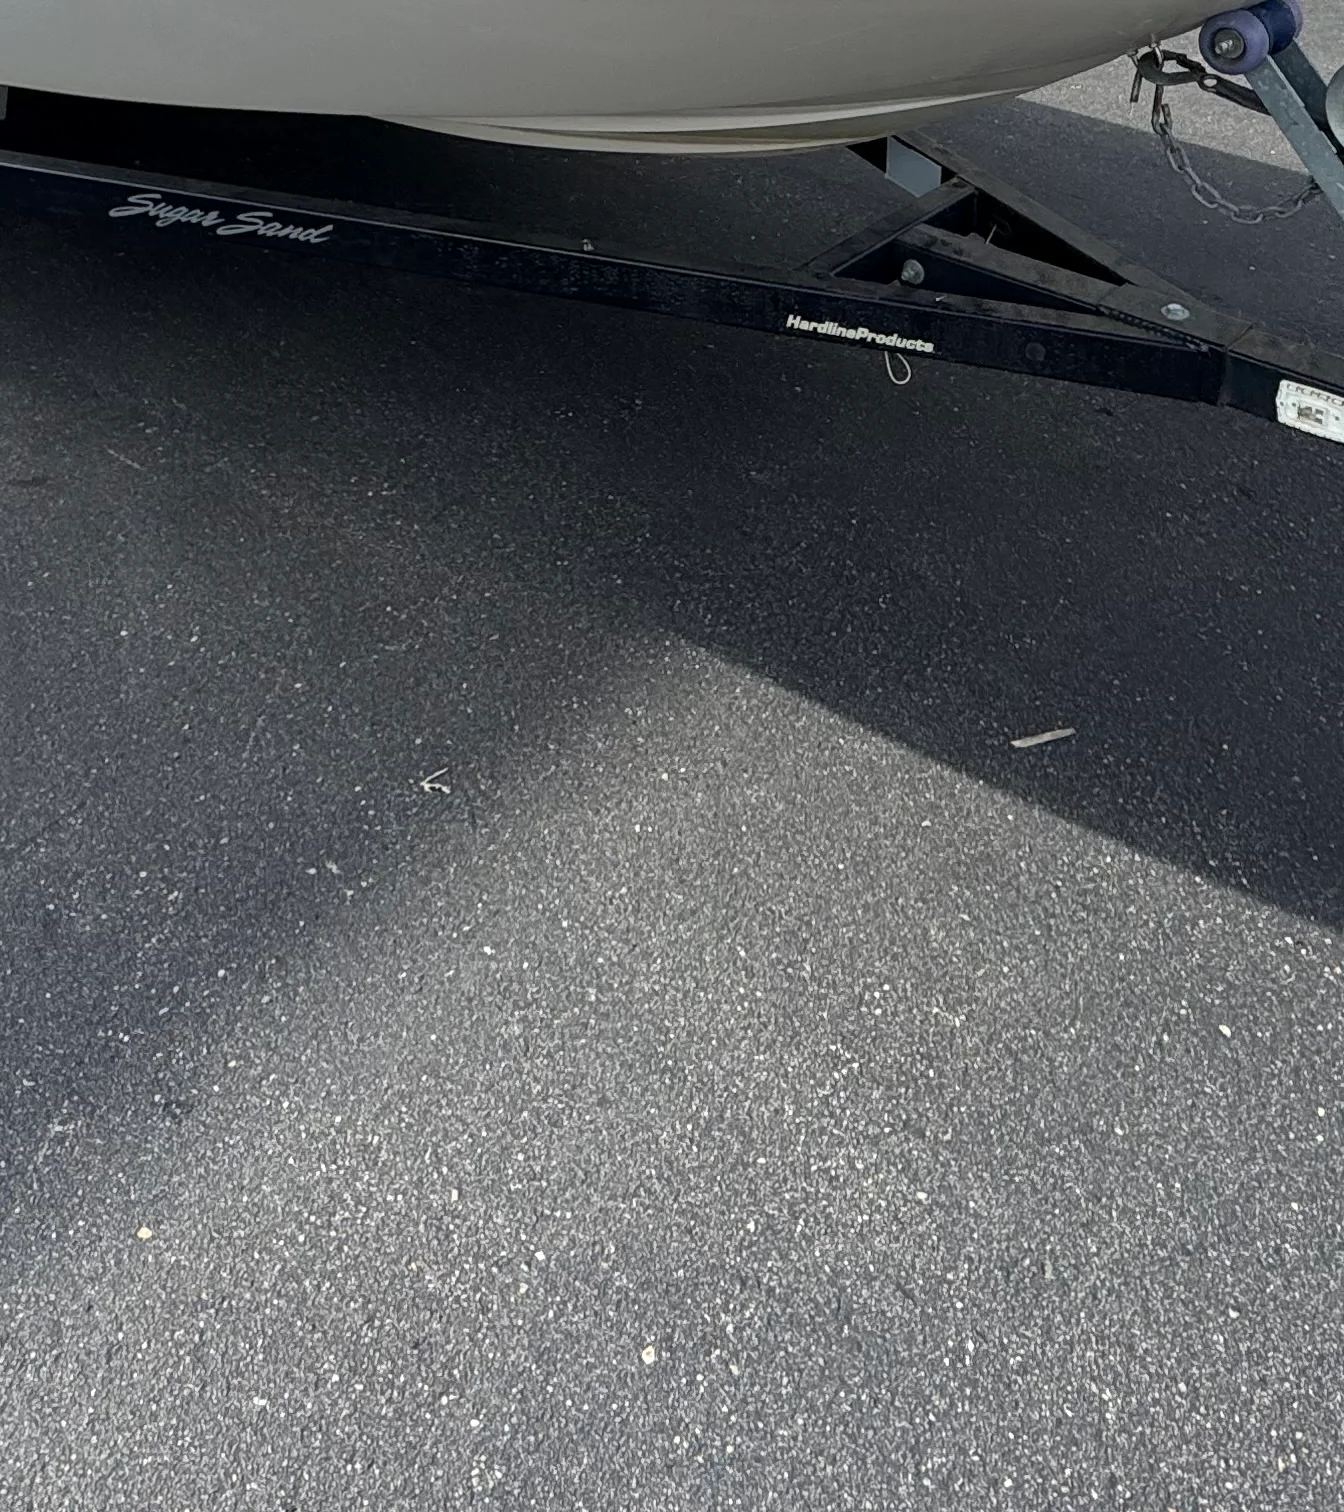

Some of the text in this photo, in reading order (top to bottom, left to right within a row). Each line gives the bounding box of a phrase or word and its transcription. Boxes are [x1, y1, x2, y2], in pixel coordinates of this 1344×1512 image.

[108, 193, 334, 244] Sugar Sand
[786, 314, 936, 354] HardlineProducts
